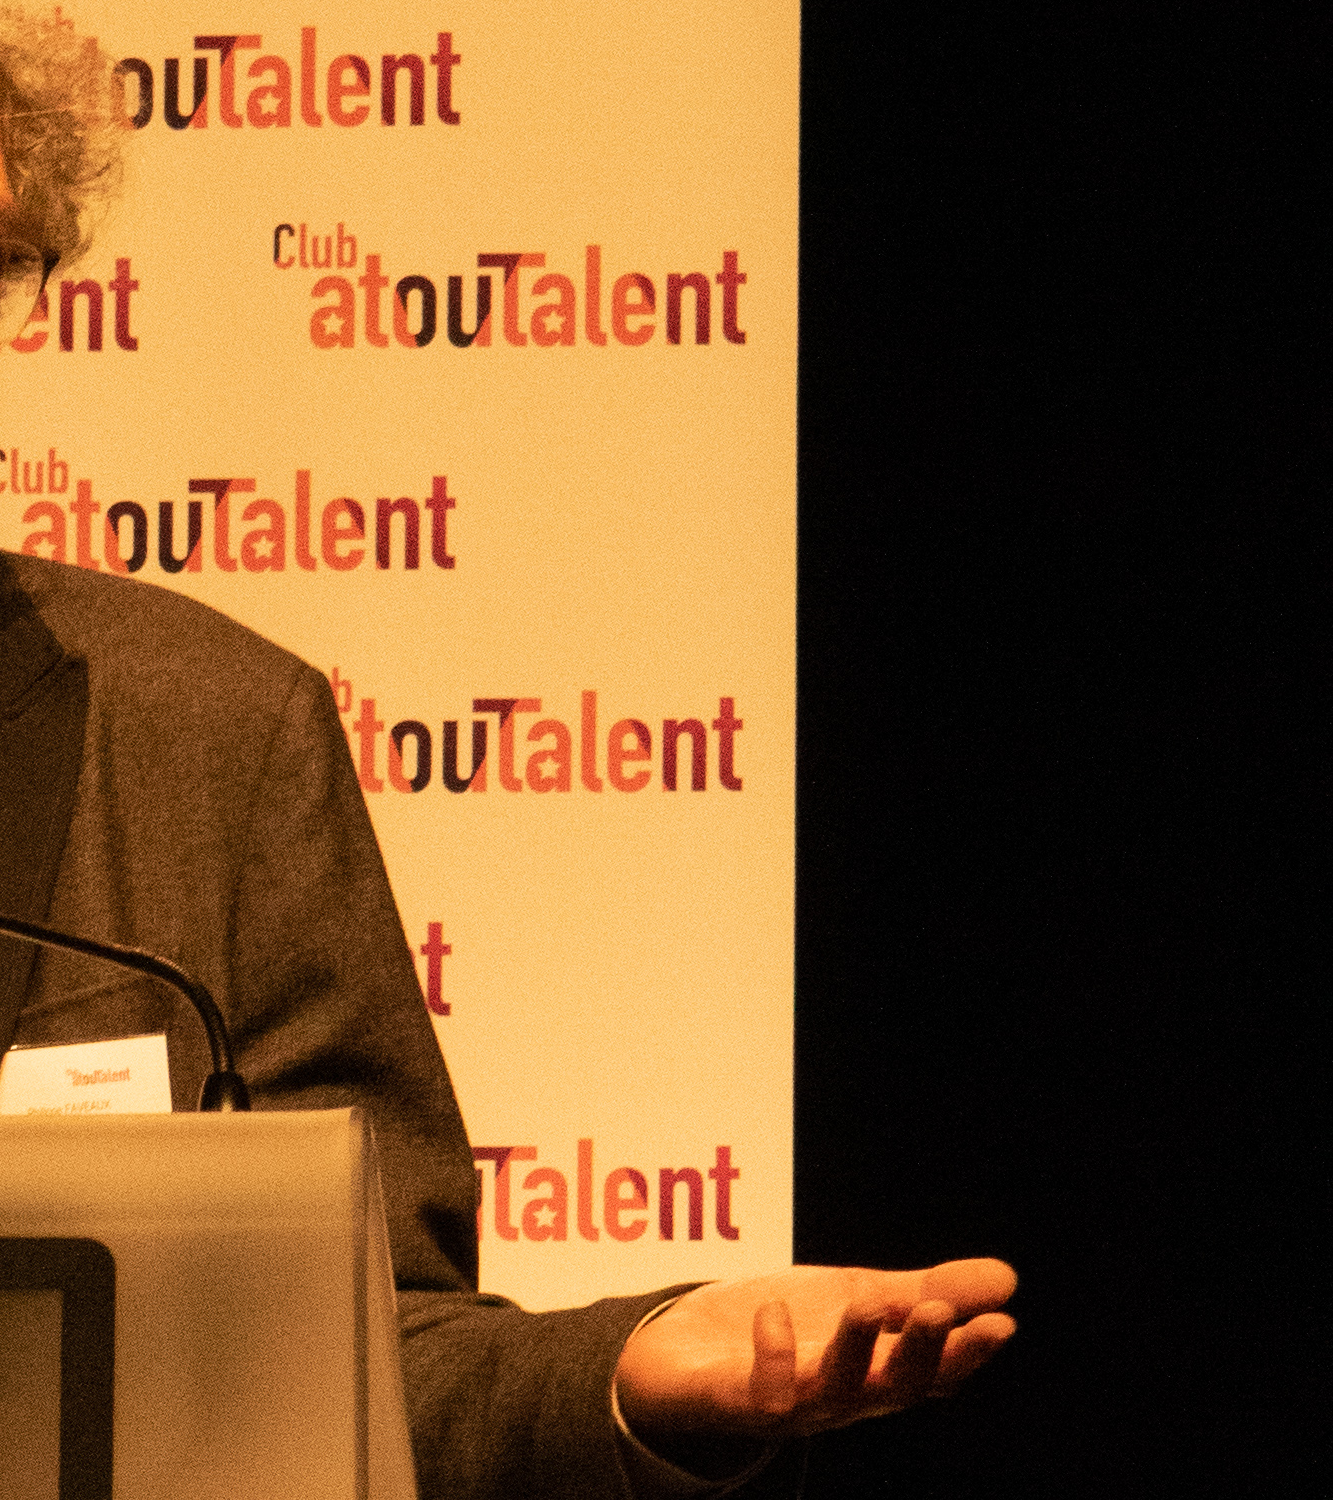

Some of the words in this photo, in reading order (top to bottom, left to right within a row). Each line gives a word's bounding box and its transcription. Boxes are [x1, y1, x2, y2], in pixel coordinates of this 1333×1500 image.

[110, 26, 461, 130] ouTalent
[274, 222, 357, 269] Club
[310, 245, 747, 349] atouTalent
[20, 470, 456, 573] atouTalent
[347, 691, 743, 794] touTalent
[471, 1138, 740, 1241] Talent
